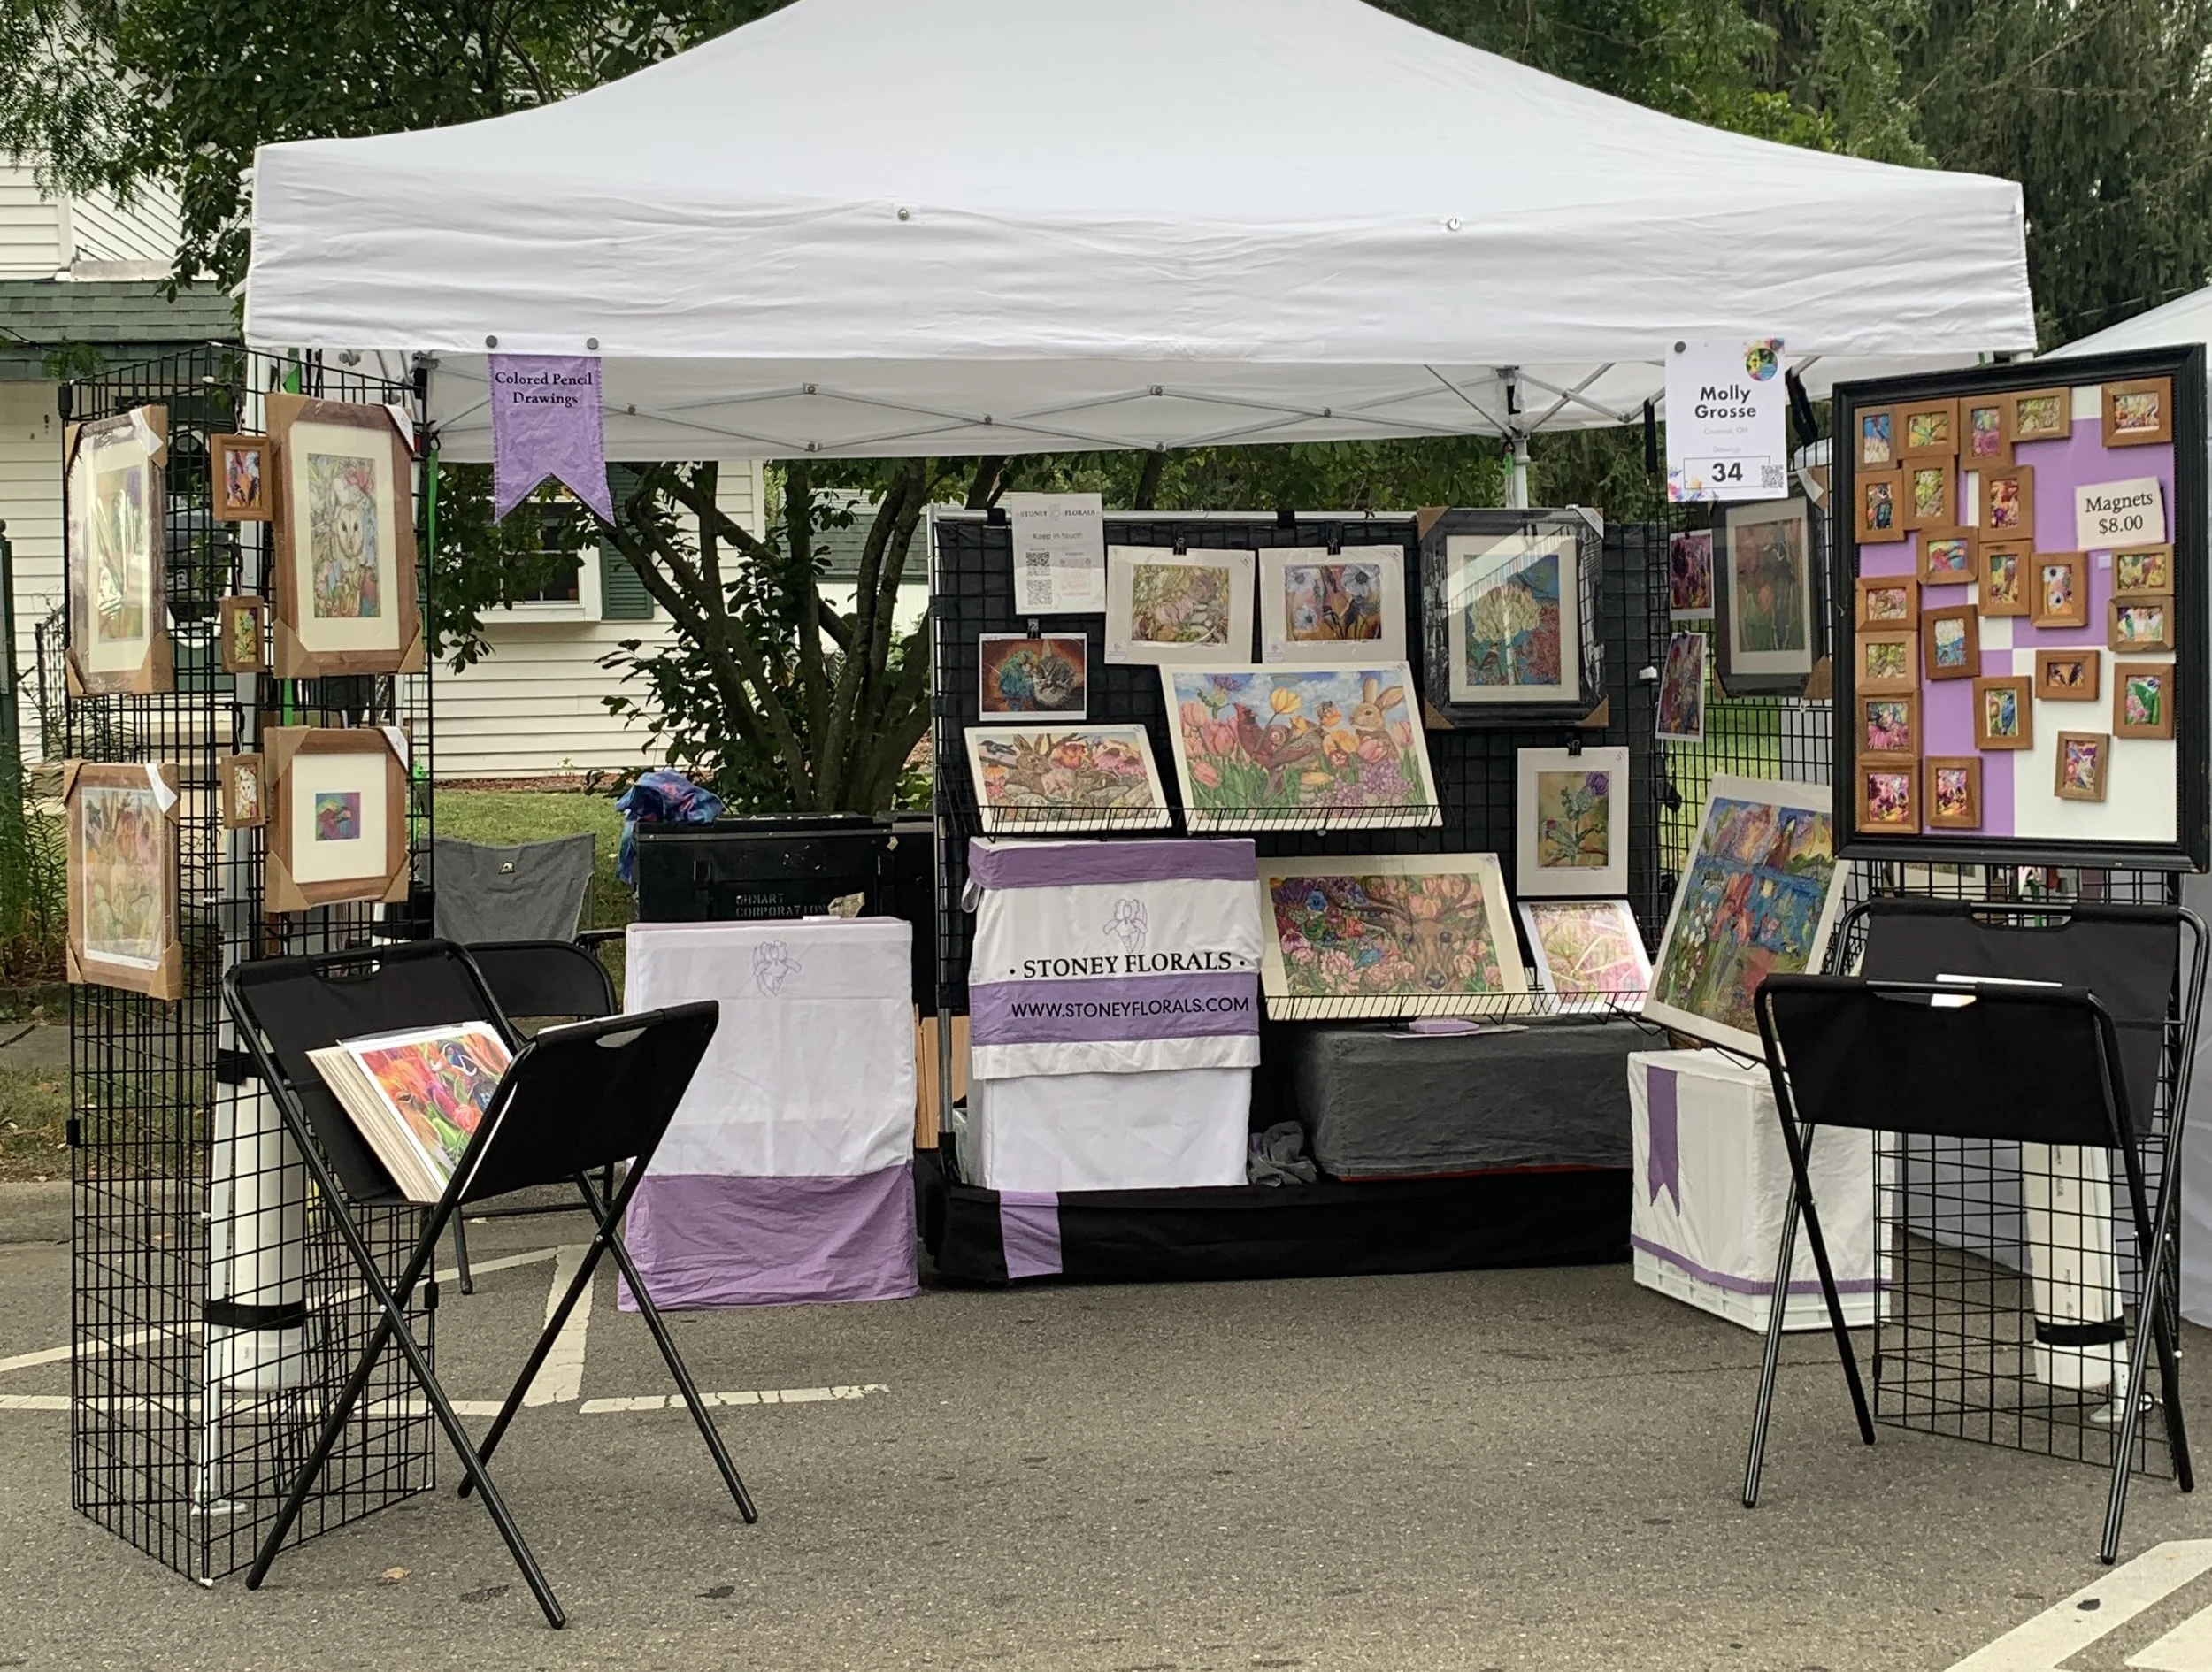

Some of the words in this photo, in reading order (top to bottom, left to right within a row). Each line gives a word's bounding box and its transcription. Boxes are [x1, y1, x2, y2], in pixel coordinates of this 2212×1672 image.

[495, 371, 549, 385] Colored
[552, 372, 593, 386] Pencil
[513, 392, 578, 408] Drawings
[1700, 384, 1751, 403] Molly
[1694, 404, 1756, 419] Grosse
[1711, 462, 1743, 483] 34
[2085, 492, 2154, 514] Magnets
[2099, 514, 2143, 535] $8.00
[736, 904, 826, 917] CORPORATION
[1023, 955, 1118, 978] STONEY
[1125, 951, 1233, 973] FLORALS
[1011, 997, 1248, 1017] WWW.STONEYFLORALS.COM
